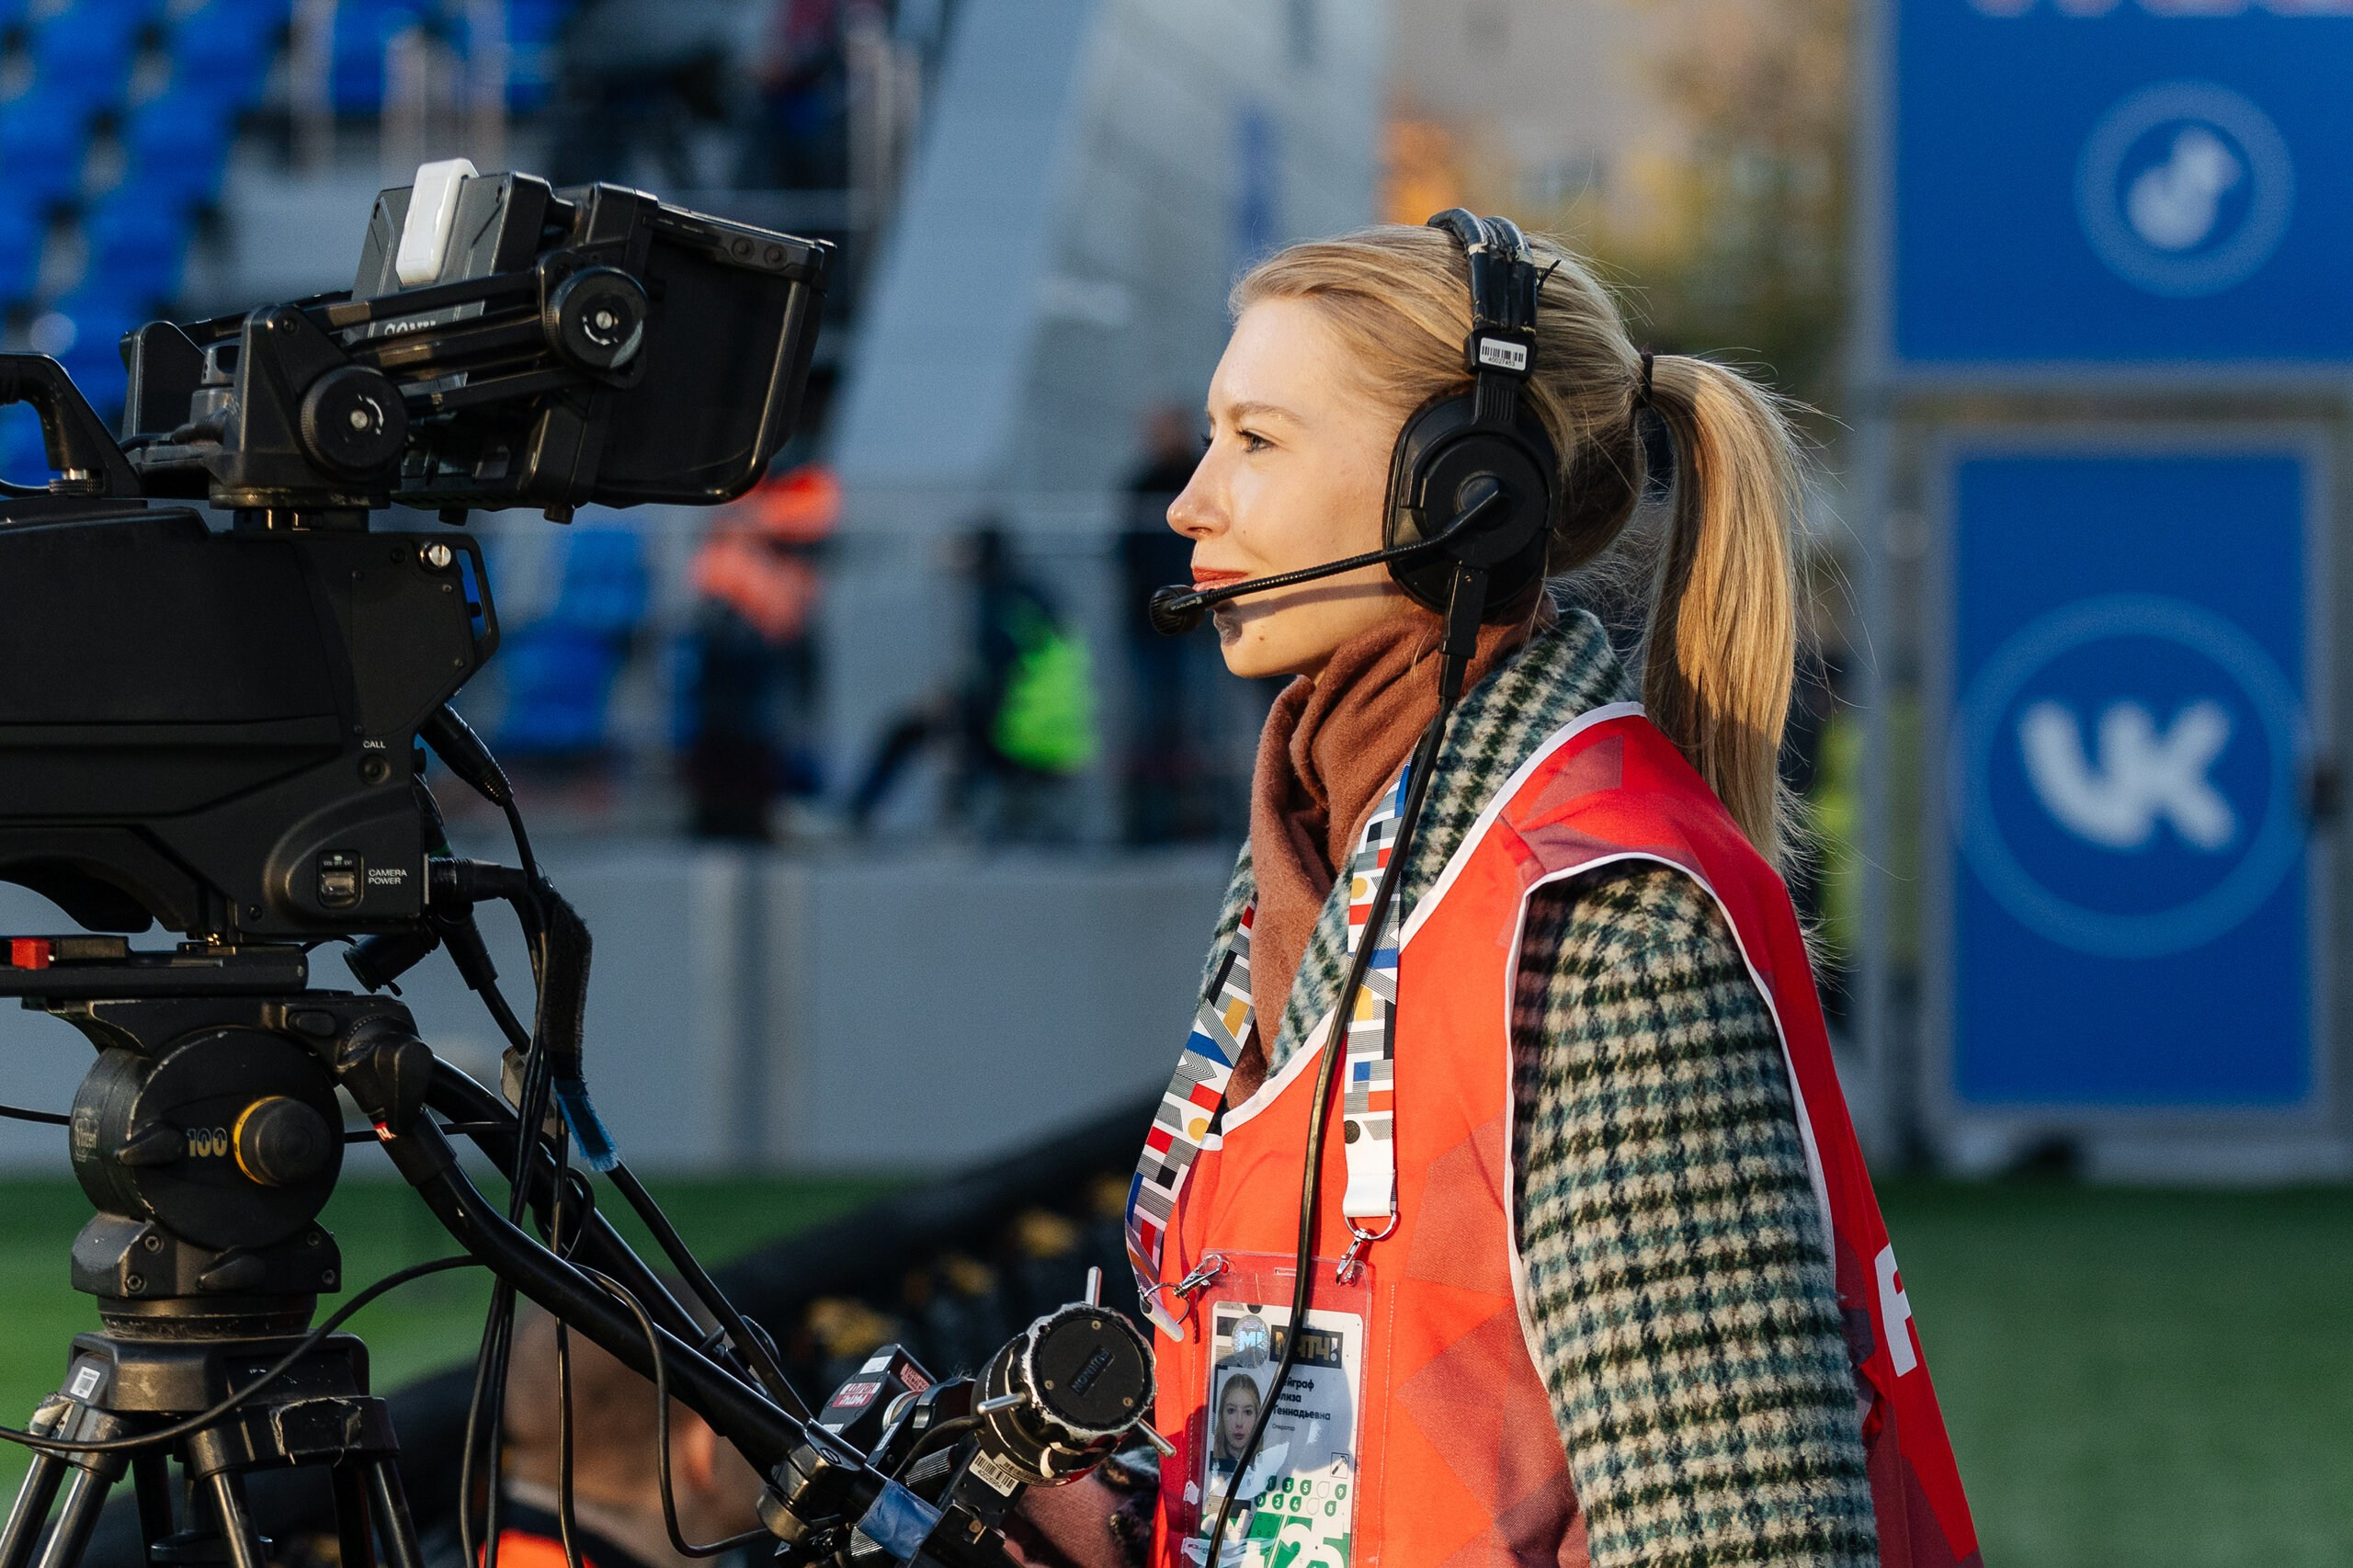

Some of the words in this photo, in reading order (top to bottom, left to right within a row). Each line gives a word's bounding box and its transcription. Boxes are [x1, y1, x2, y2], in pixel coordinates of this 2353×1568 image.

[363, 740, 386, 749] CALL
[2020, 701, 2237, 851] VK
[369, 869, 407, 877] CAMERA
[187, 1127, 228, 1157] 100
